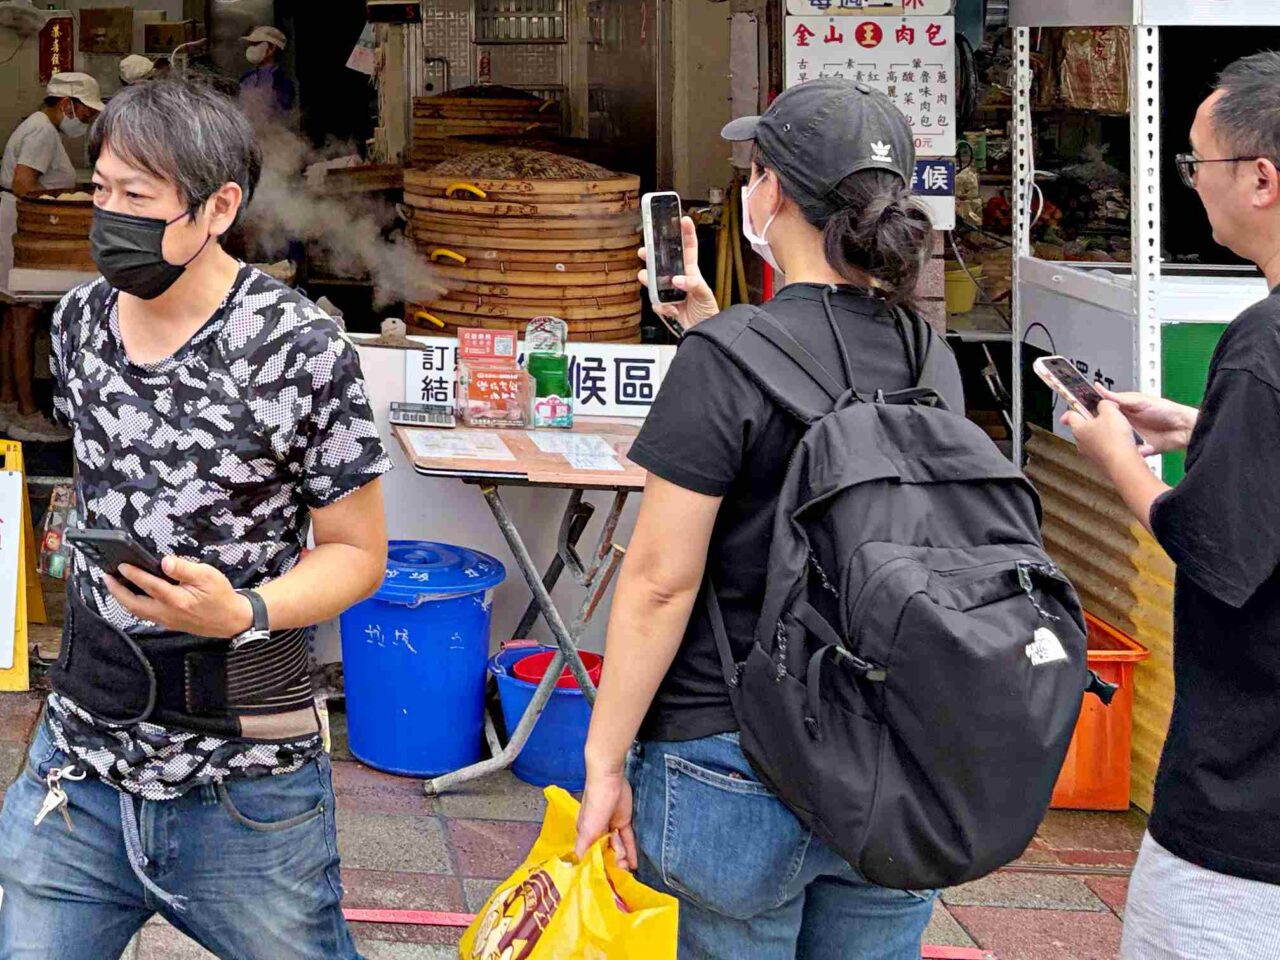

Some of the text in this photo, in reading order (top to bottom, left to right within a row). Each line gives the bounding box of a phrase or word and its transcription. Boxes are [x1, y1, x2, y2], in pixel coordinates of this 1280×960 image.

[918, 70, 932, 127] 魯味肉包
[421, 375, 458, 402] 結
[542, 354, 656, 408] 候區
